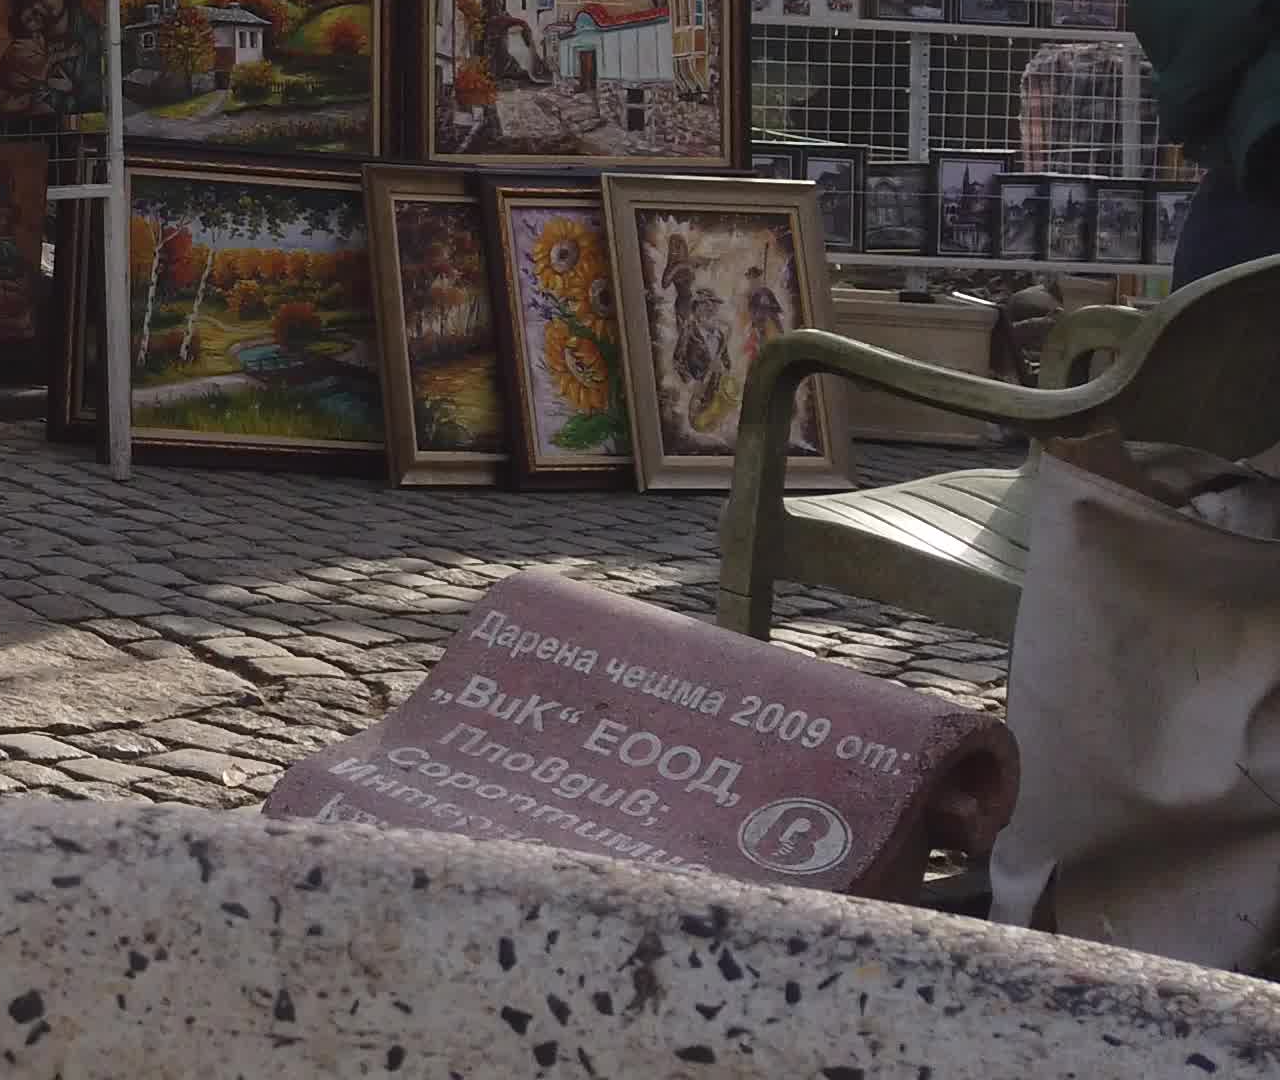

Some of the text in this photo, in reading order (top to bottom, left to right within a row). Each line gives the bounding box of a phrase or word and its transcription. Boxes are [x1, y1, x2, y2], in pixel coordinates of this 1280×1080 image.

[469, 609, 912, 776] Дарена чешма 2009 от:
[436, 722, 672, 827] Пловдив;
[581, 718, 743, 808] ЕООД,
